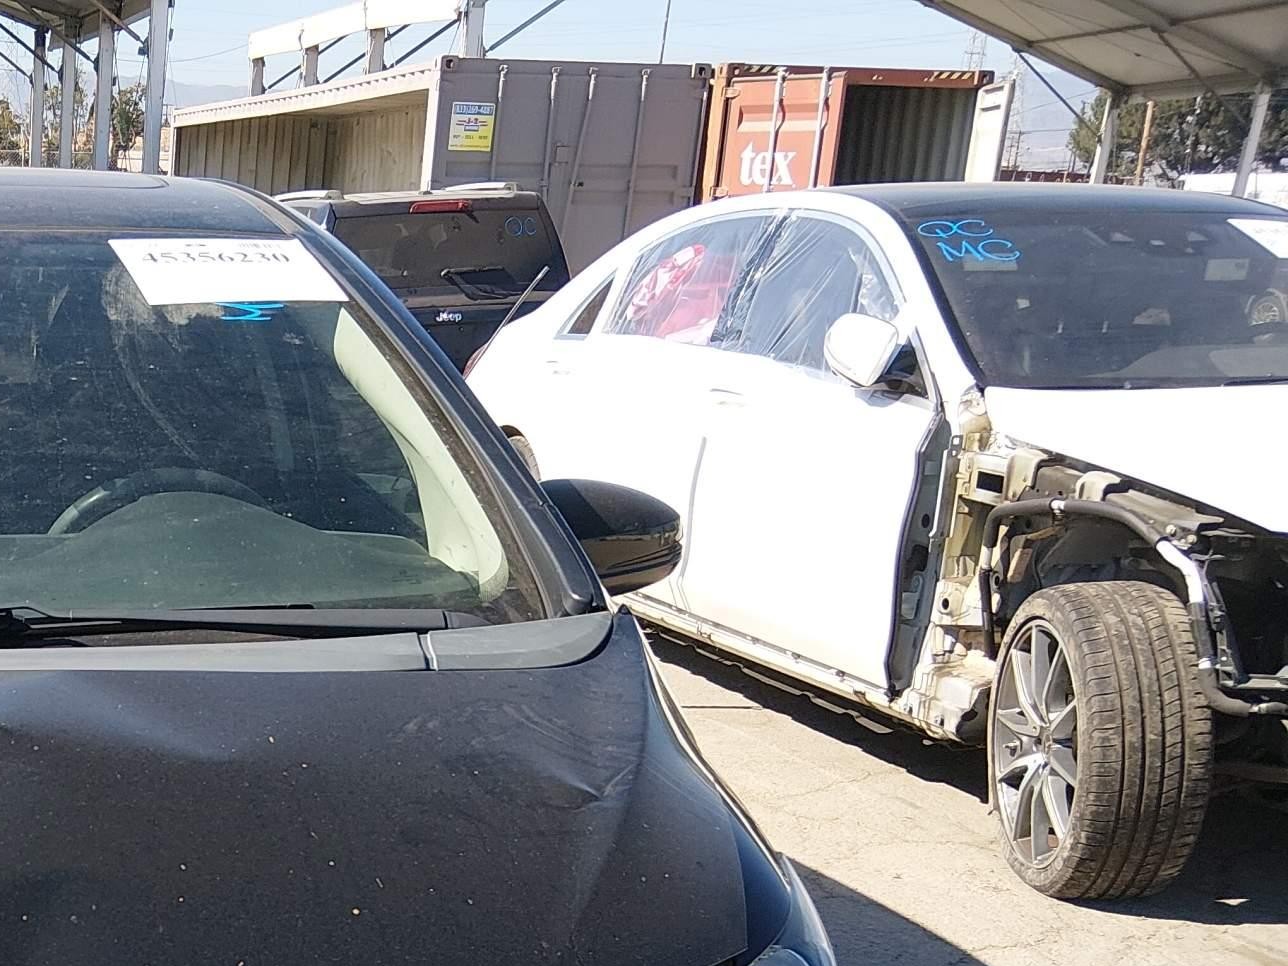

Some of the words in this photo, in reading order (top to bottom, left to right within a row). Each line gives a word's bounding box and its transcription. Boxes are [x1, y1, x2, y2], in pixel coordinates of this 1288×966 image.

[740, 141, 797, 185] tex
[917, 219, 993, 238] QC
[143, 252, 290, 264] 45356230
[936, 239, 1020, 261] MC
[435, 311, 463, 323] Jeep
